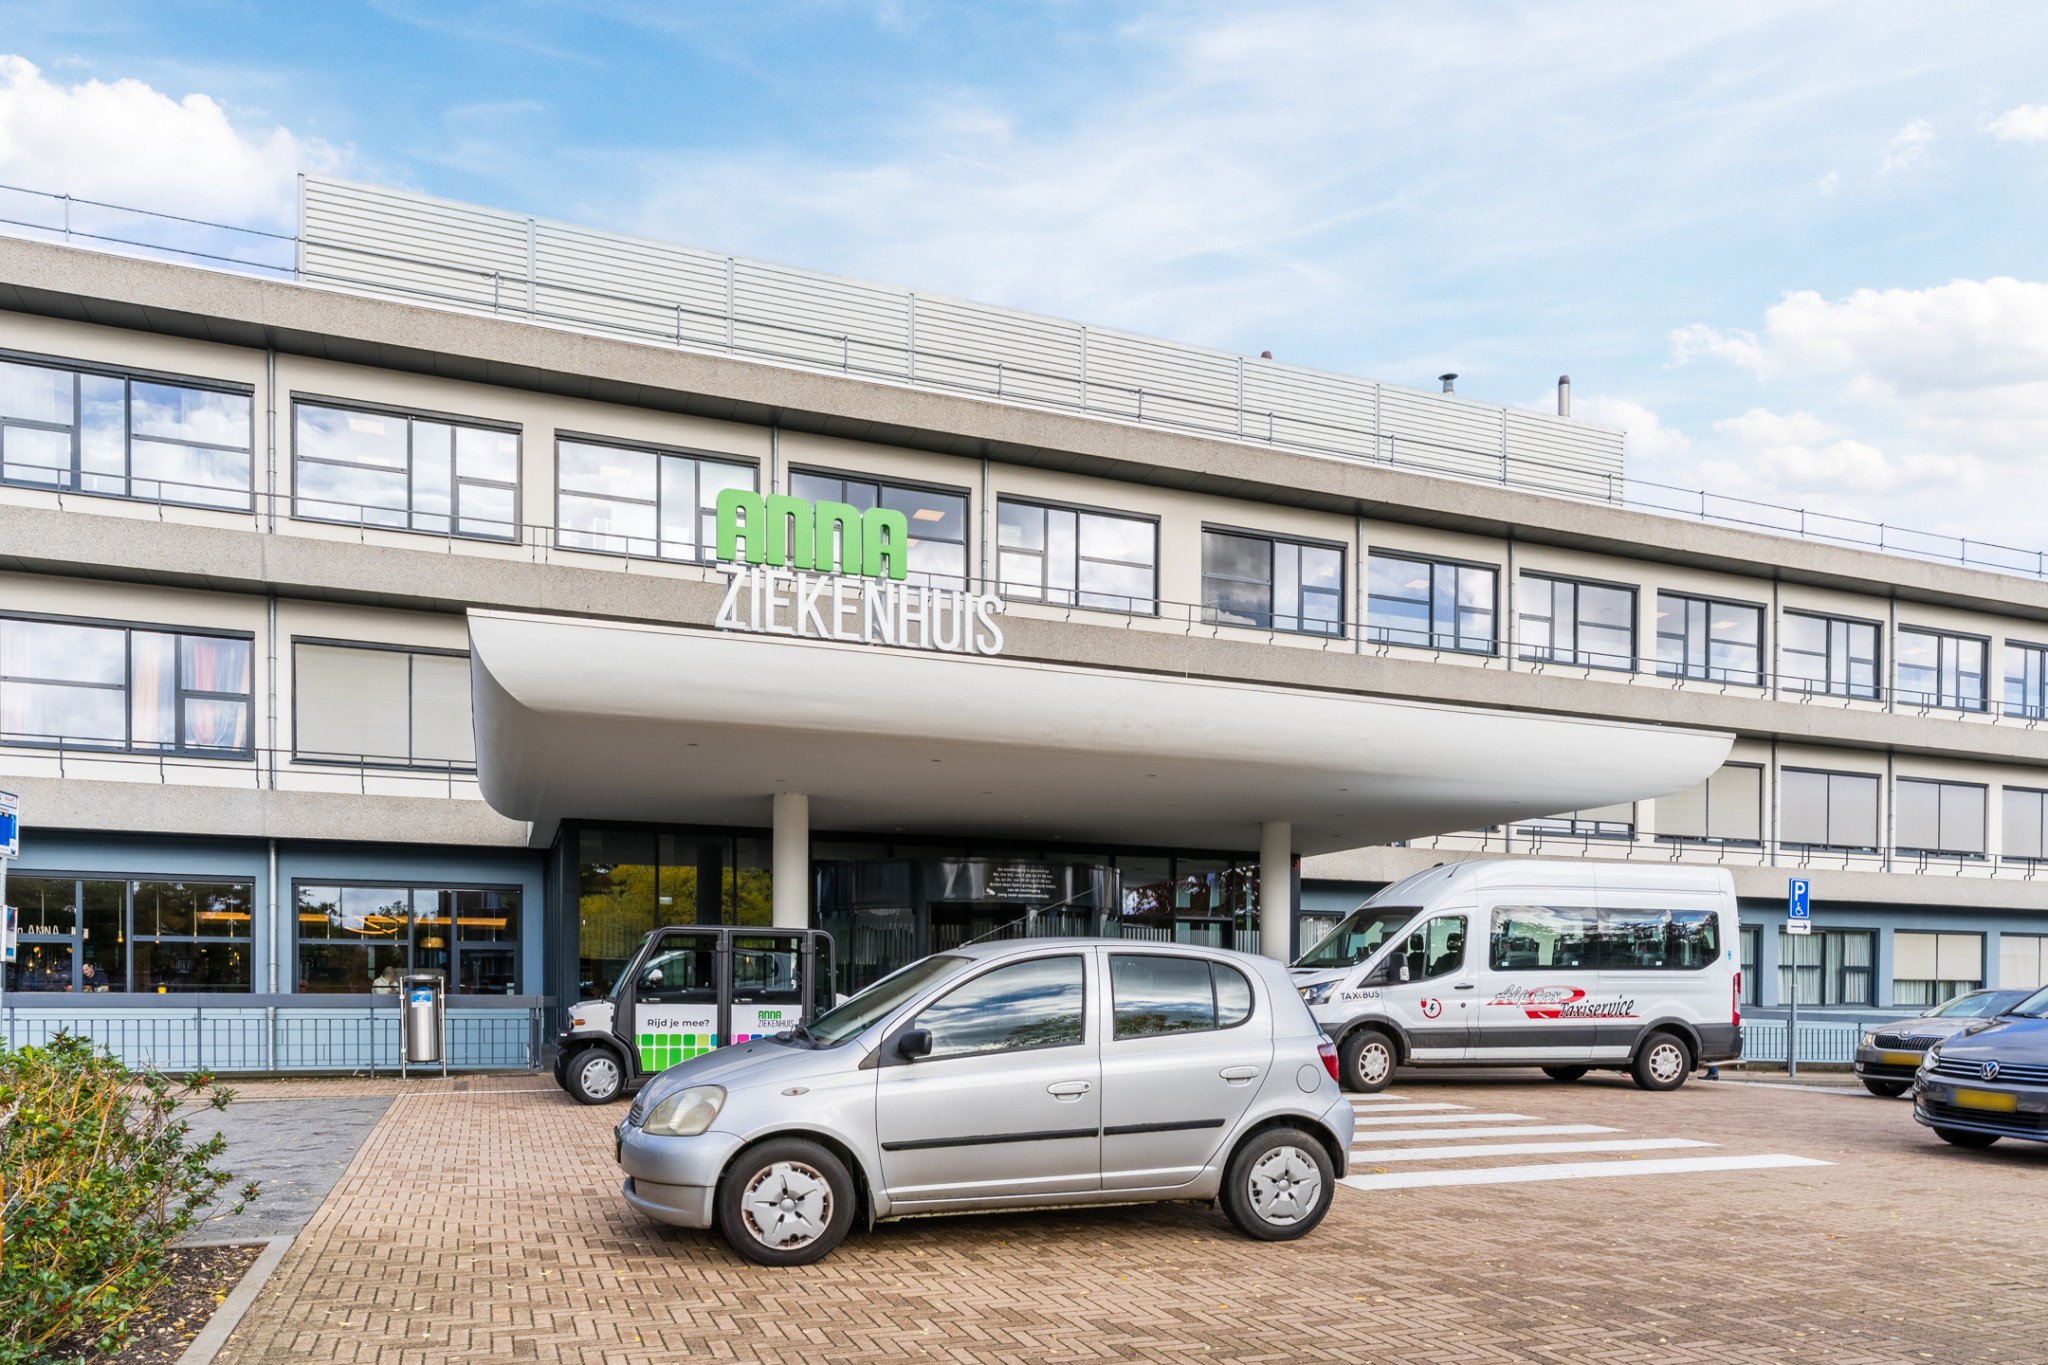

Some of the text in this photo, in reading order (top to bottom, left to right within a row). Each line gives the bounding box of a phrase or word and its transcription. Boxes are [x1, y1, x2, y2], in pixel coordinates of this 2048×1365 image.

[716, 488, 908, 581] ANNA
[715, 563, 1004, 656] ZIEKENHUIS
[1795, 882, 1806, 901] P
[1560, 995, 1635, 1017] Taxiservice
[647, 1018, 710, 1028] Rijd je mee?
[758, 1020, 795, 1028] ZIEKENHUIS
